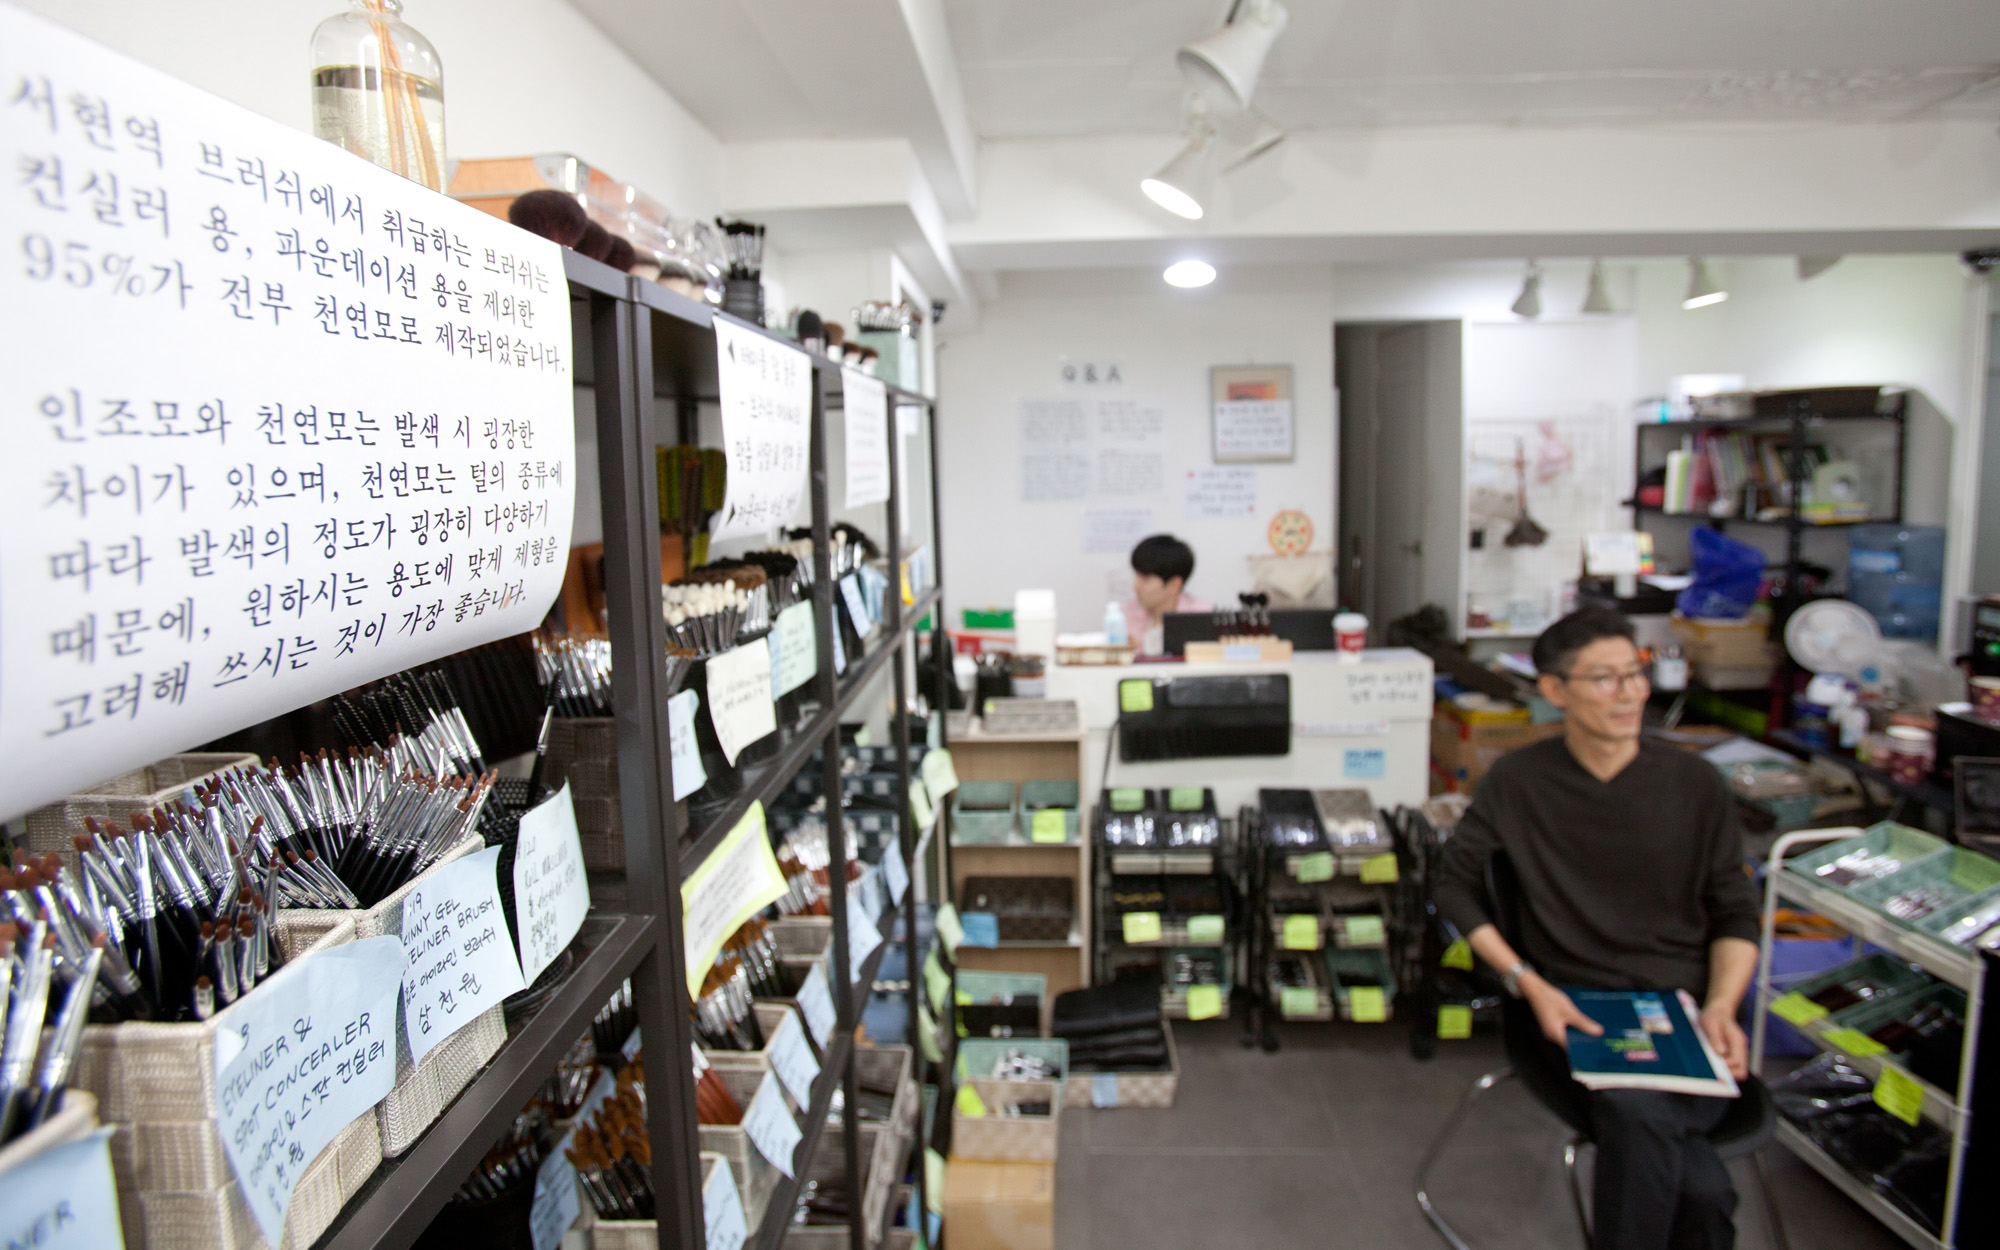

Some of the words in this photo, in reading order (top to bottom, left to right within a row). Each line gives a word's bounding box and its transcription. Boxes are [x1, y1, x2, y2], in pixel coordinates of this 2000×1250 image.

[10, 75, 163, 169] 서현역
[196, 141, 364, 235] 브러쉬에서
[382, 209, 472, 268] 취급하는
[483, 247, 550, 294] 브러쉬는
[17, 152, 169, 239] 컨실러
[201, 205, 253, 261] 용,
[275, 227, 418, 301] 파운데이션
[431, 273, 473, 314] 용을
[483, 289, 535, 329] 제외한
[22, 233, 194, 310] 95%가
[220, 274, 293, 326] 전부
[313, 294, 423, 345] 천연모로
[435, 321, 565, 373] 제작되었습니다.
[38, 387, 233, 446] 인조모와
[255, 402, 381, 447] 천연모는
[395, 411, 439, 449] 발색
[453, 415, 471, 449] 시
[483, 418, 535, 449] 굉장한
[42, 463, 195, 519] 차이가
[227, 462, 339, 510] 있으며,
[361, 461, 456, 499] 천연모는
[470, 460, 505, 493] 털의
[517, 460, 563, 490] 종류에
[48, 534, 153, 594] 따라
[179, 522, 289, 577] 발색의
[313, 513, 397, 559] 정도가
[410, 506, 471, 546] 굉장히
[484, 499, 549, 534] 다양하기
[50, 596, 211, 664] 때문에,
[242, 572, 369, 627] 원하시는
[386, 553, 453, 598] 용도에
[468, 545, 503, 581] 맞게
[513, 536, 558, 569] 제형을
[44, 661, 190, 738] 고려해
[213, 636, 318, 688] 쓰시는
[334, 613, 387, 659] 것이
[397, 599, 445, 637] 가장
[455, 579, 526, 623] 좋습니다.
[420, 948, 457, 986] 아이라인
[463, 926, 496, 957] 브러쉬
[435, 899, 460, 920] GEL
[457, 896, 495, 928] BRUSH
[459, 972, 482, 995] 원
[222, 1035, 290, 1118] EYELINER
[293, 1016, 312, 1042] &
[235, 1103, 260, 1152] SPOT
[265, 1012, 371, 1110] CONCEALER
[336, 1040, 385, 1084] 컨실러
